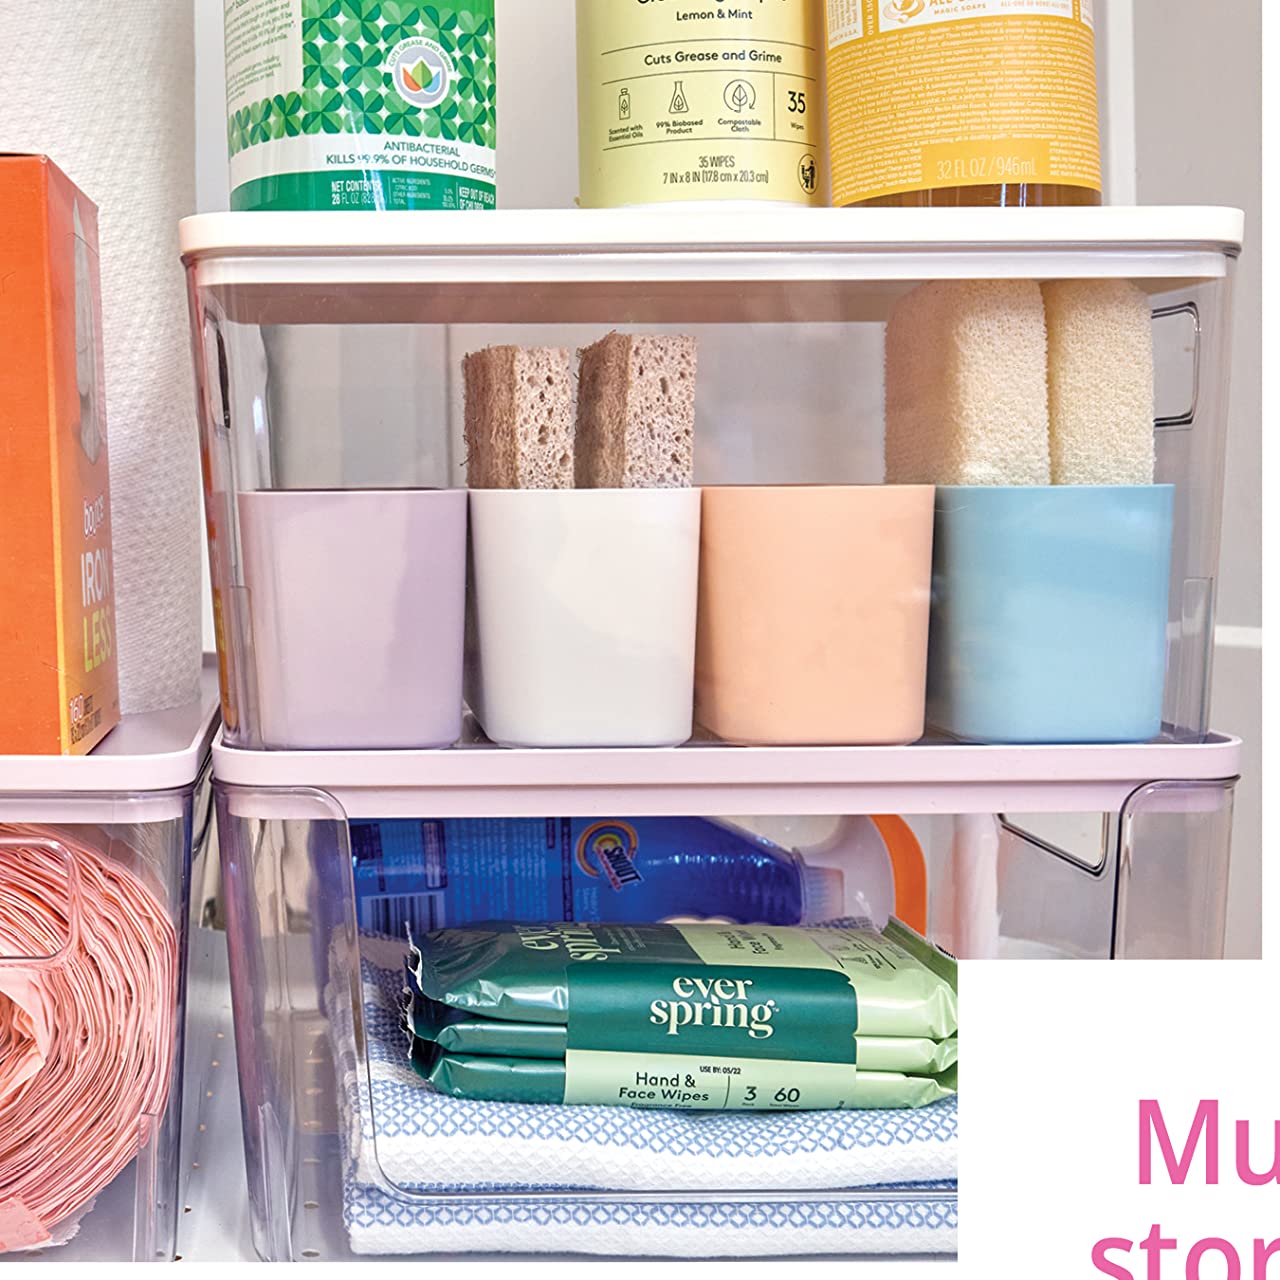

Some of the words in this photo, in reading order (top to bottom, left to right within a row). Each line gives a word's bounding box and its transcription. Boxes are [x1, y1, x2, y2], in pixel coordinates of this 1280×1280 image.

[676, 11, 714, 21] Lemon
[717, 9, 725, 19] &
[728, 9, 753, 19] Mint
[934, 7, 958, 15] MAGIC
[961, 3, 986, 13] SOAPS
[867, 15, 875, 35] OVER
[644, 54, 672, 66] Cuts
[674, 51, 719, 63] Grease
[722, 50, 746, 61] and
[749, 50, 782, 63] Grime
[787, 91, 806, 114] 35
[717, 118, 762, 127] Compostable
[666, 127, 693, 135] Product
[384, 141, 460, 157] ANTIBACTERIAL
[326, 154, 355, 164] KILLS
[391, 155, 408, 165] OF
[410, 155, 469, 171] HOUSEHOLD
[699, 156, 709, 168] 35
[710, 156, 735, 168] WIPES
[937, 160, 952, 180] 32
[954, 160, 968, 178] FL
[331, 181, 344, 192] NET
[332, 193, 341, 205] 28
[83, 614, 112, 673] LESS
[672, 976, 754, 1001] ever
[649, 996, 777, 1039] spring
[699, 1065, 712, 1074] USE
[722, 1066, 742, 1075] 05/22
[636, 1072, 680, 1087] Hand
[684, 1074, 697, 1088] &
[619, 1088, 656, 1099] Face
[661, 1089, 709, 1103] Wipes
[745, 1086, 758, 1101] 3
[774, 1087, 800, 1102] 60
